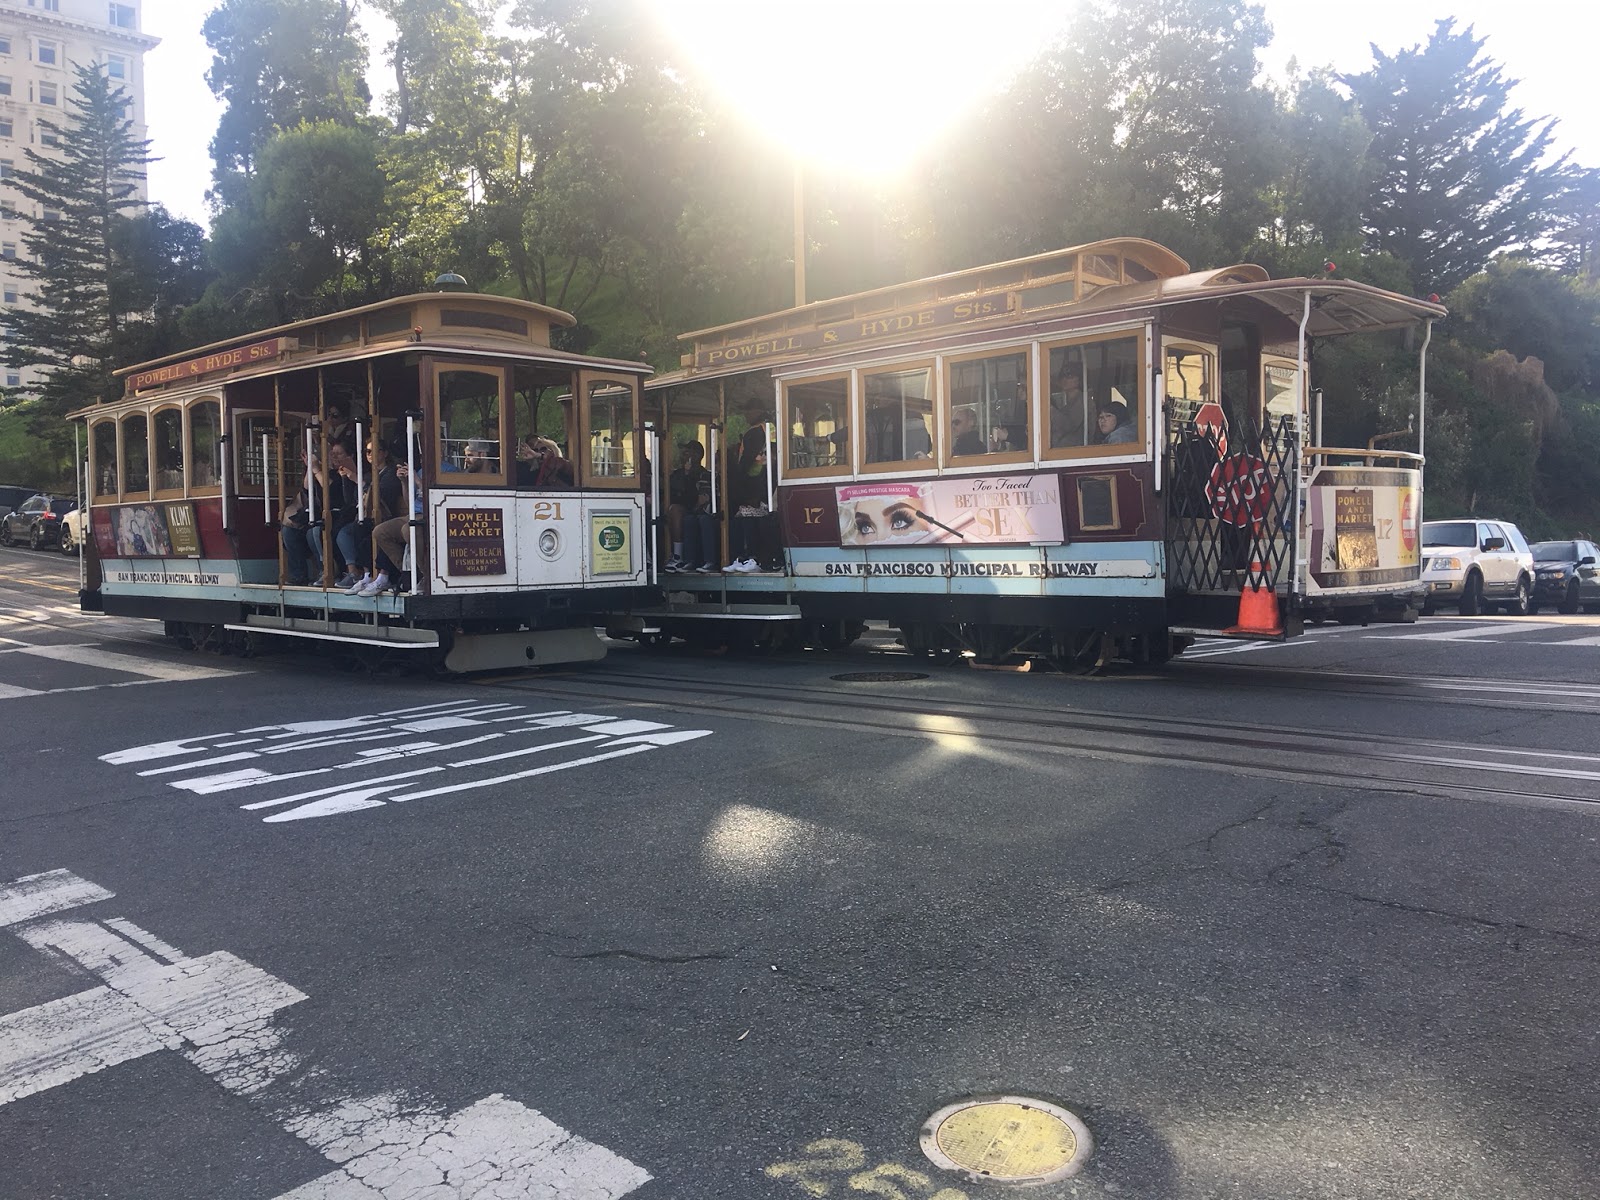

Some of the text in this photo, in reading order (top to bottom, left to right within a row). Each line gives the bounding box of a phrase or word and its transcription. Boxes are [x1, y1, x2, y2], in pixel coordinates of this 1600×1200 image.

[708, 302, 997, 363] POWELL & HYDE Sts.
[137, 346, 272, 386] POWELL & HYDE Sts.
[972, 476, 1033, 492] Too Faced
[954, 489, 1057, 508] BETTER THAN
[1338, 497, 1372, 506] POWELL
[449, 513, 500, 521] POWELL
[534, 502, 564, 521] 21
[804, 507, 825, 524] 17
[1337, 514, 1372, 524] MARKET
[975, 507, 1039, 536] SEX
[1377, 519, 1394, 539] 17
[449, 528, 501, 537] MARKET
[450, 548, 468, 557] HYDE
[479, 547, 502, 557] BEACH
[825, 563, 1099, 576] SAN FRANCISCO MUNICIPAL RAILWAY
[118, 572, 130, 581] SAN
[194, 574, 219, 585] RAILWAY
